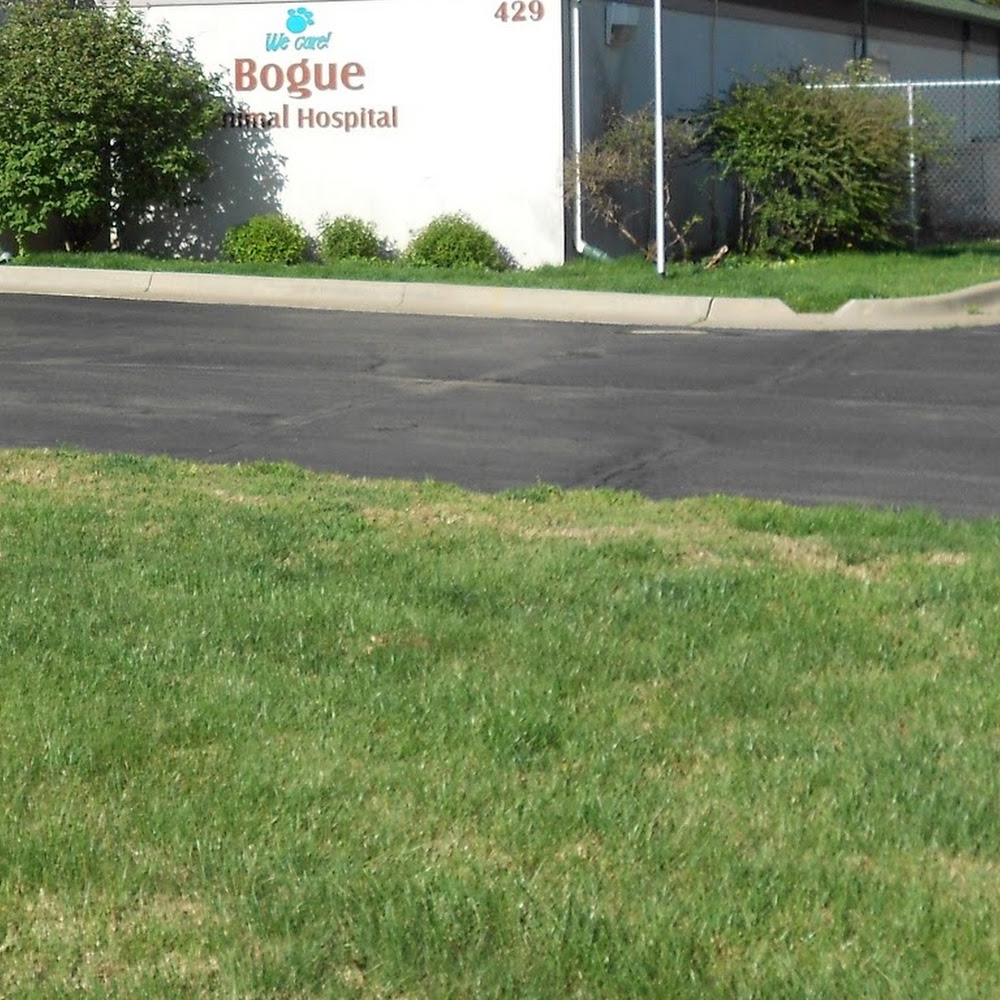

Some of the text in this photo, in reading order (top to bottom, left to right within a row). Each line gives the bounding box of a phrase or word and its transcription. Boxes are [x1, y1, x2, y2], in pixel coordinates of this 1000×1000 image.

[494, 0, 545, 22] 429
[265, 31, 333, 52] We care!
[234, 58, 366, 99] Bogue
[222, 104, 398, 132] nimal Hospital
